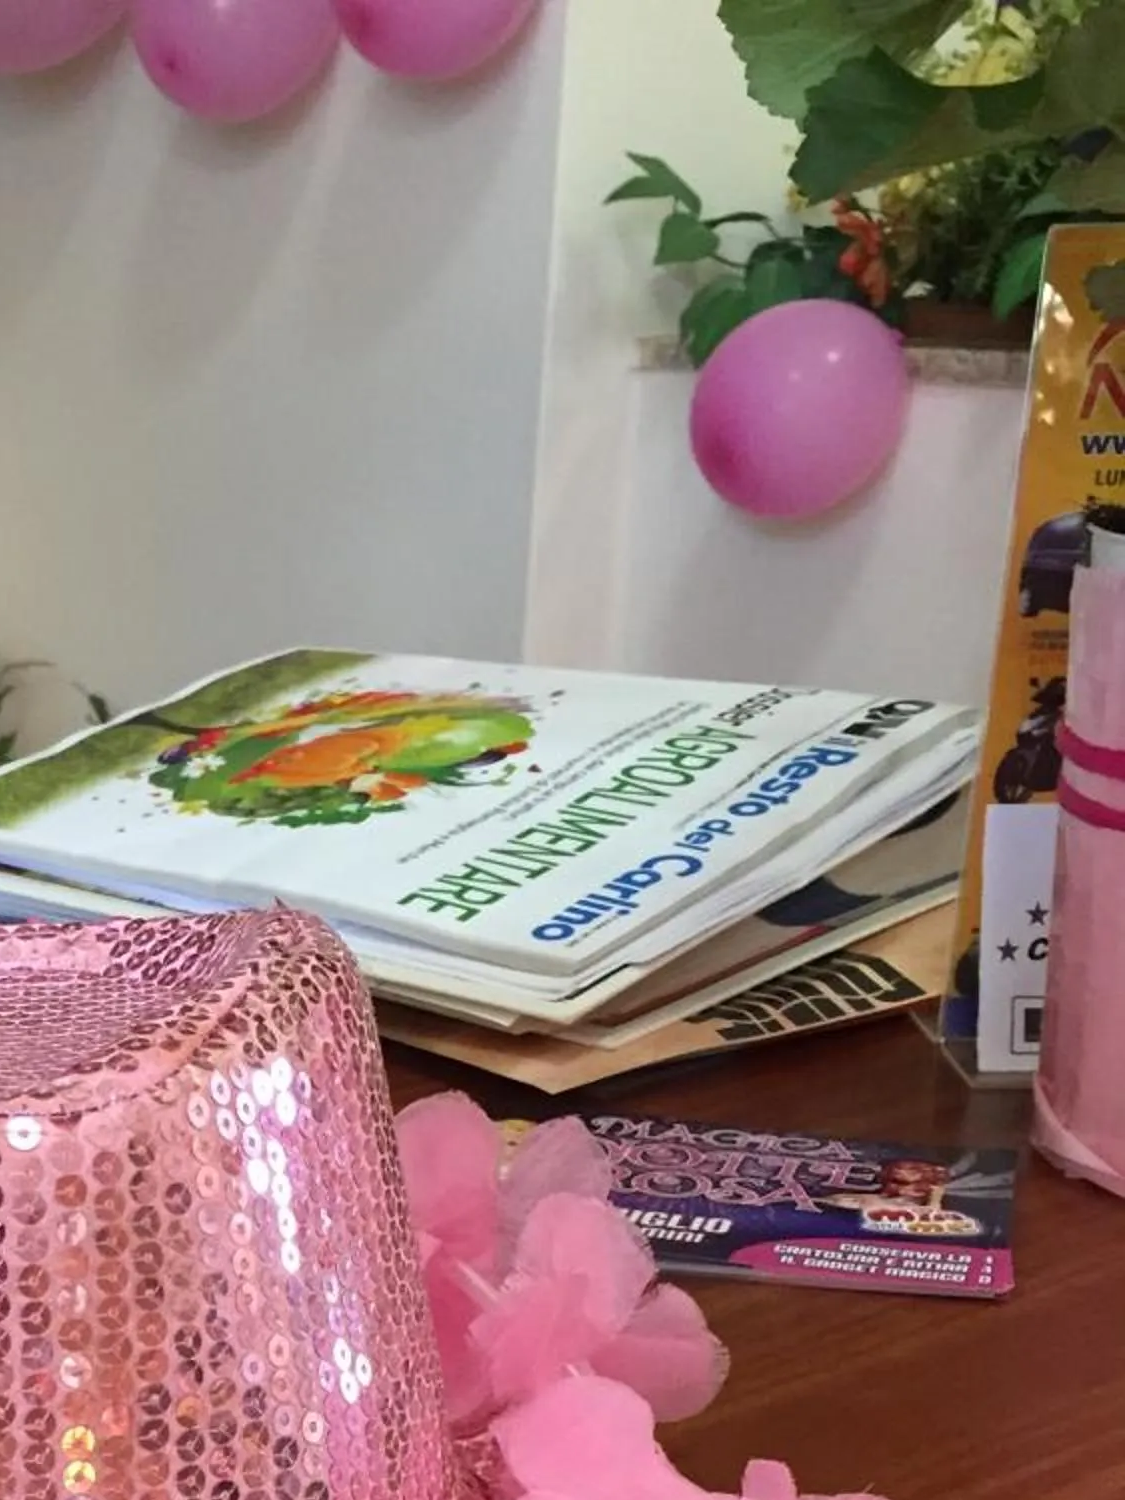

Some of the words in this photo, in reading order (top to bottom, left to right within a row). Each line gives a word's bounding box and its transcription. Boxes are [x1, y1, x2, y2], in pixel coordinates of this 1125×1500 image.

[728, 746, 860, 817] Resto
[396, 725, 757, 922] AGROALIMENTARE
[674, 818, 735, 853] del
[531, 853, 704, 942] Carlino
[590, 1116, 856, 1161] MAGICA
[619, 1208, 733, 1234] UGLIO
